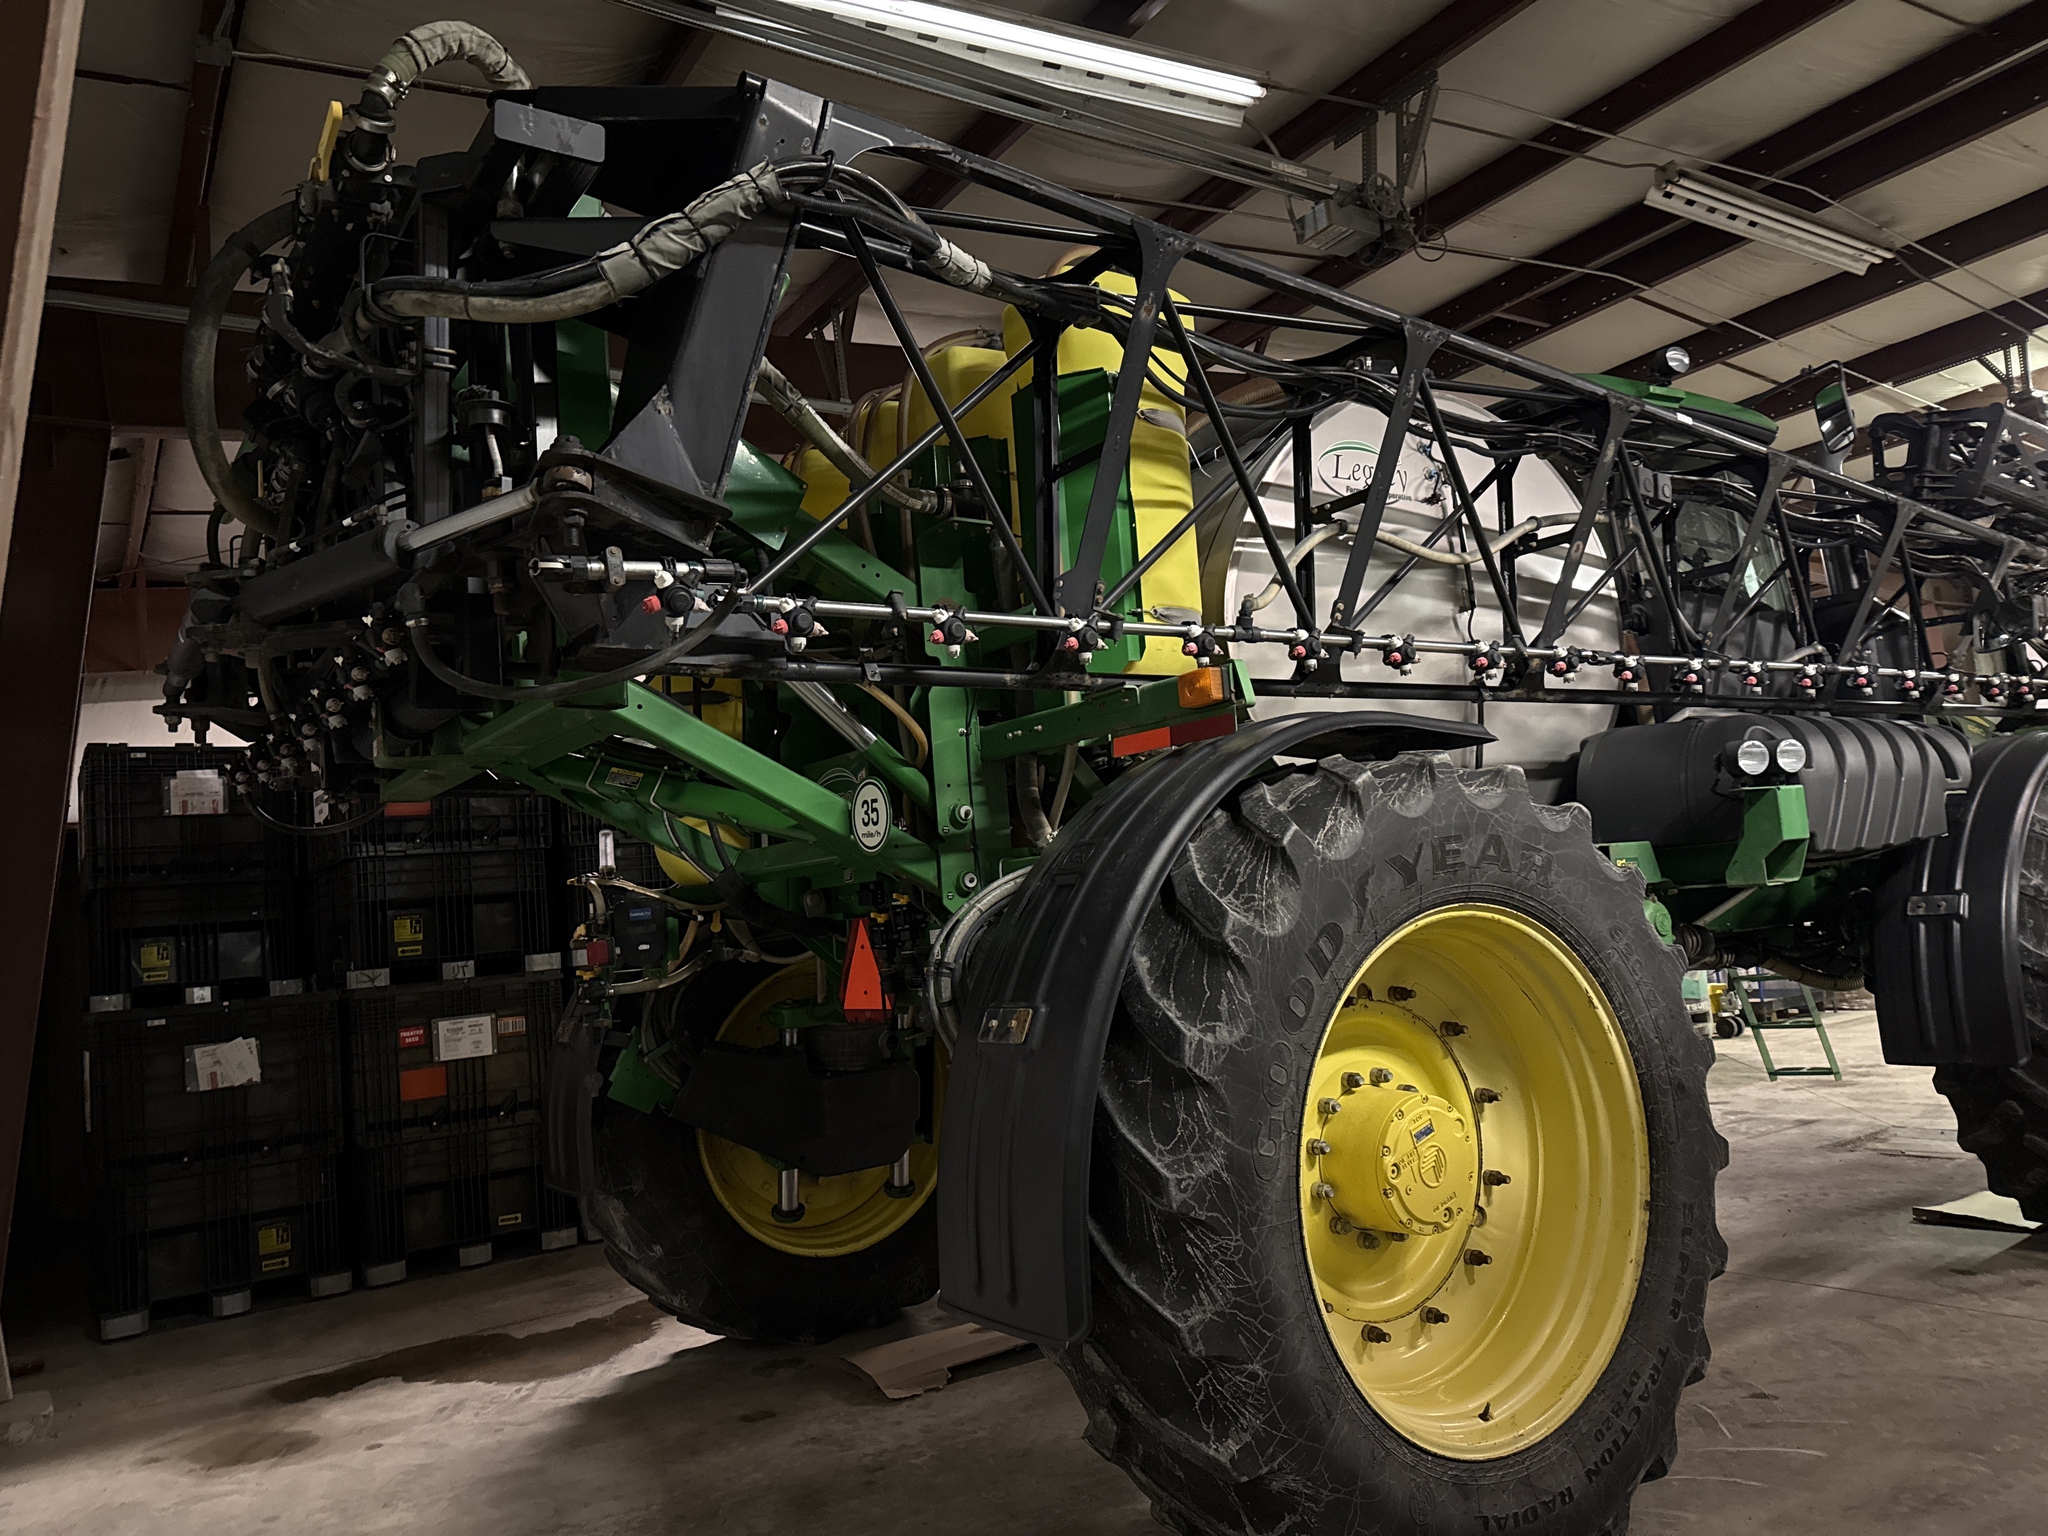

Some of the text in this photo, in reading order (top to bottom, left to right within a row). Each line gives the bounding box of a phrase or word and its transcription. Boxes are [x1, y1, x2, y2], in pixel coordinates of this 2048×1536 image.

[1332, 453, 1408, 493] Legy
[861, 798, 880, 827] 35
[861, 830, 882, 839] mile/h
[400, 1029, 424, 1037] TREATED
[405, 1036, 420, 1044] SEED
[1473, 1203, 1695, 1533] SUPER TRACTION RADIAL
[1593, 1369, 1642, 1445] DT820
